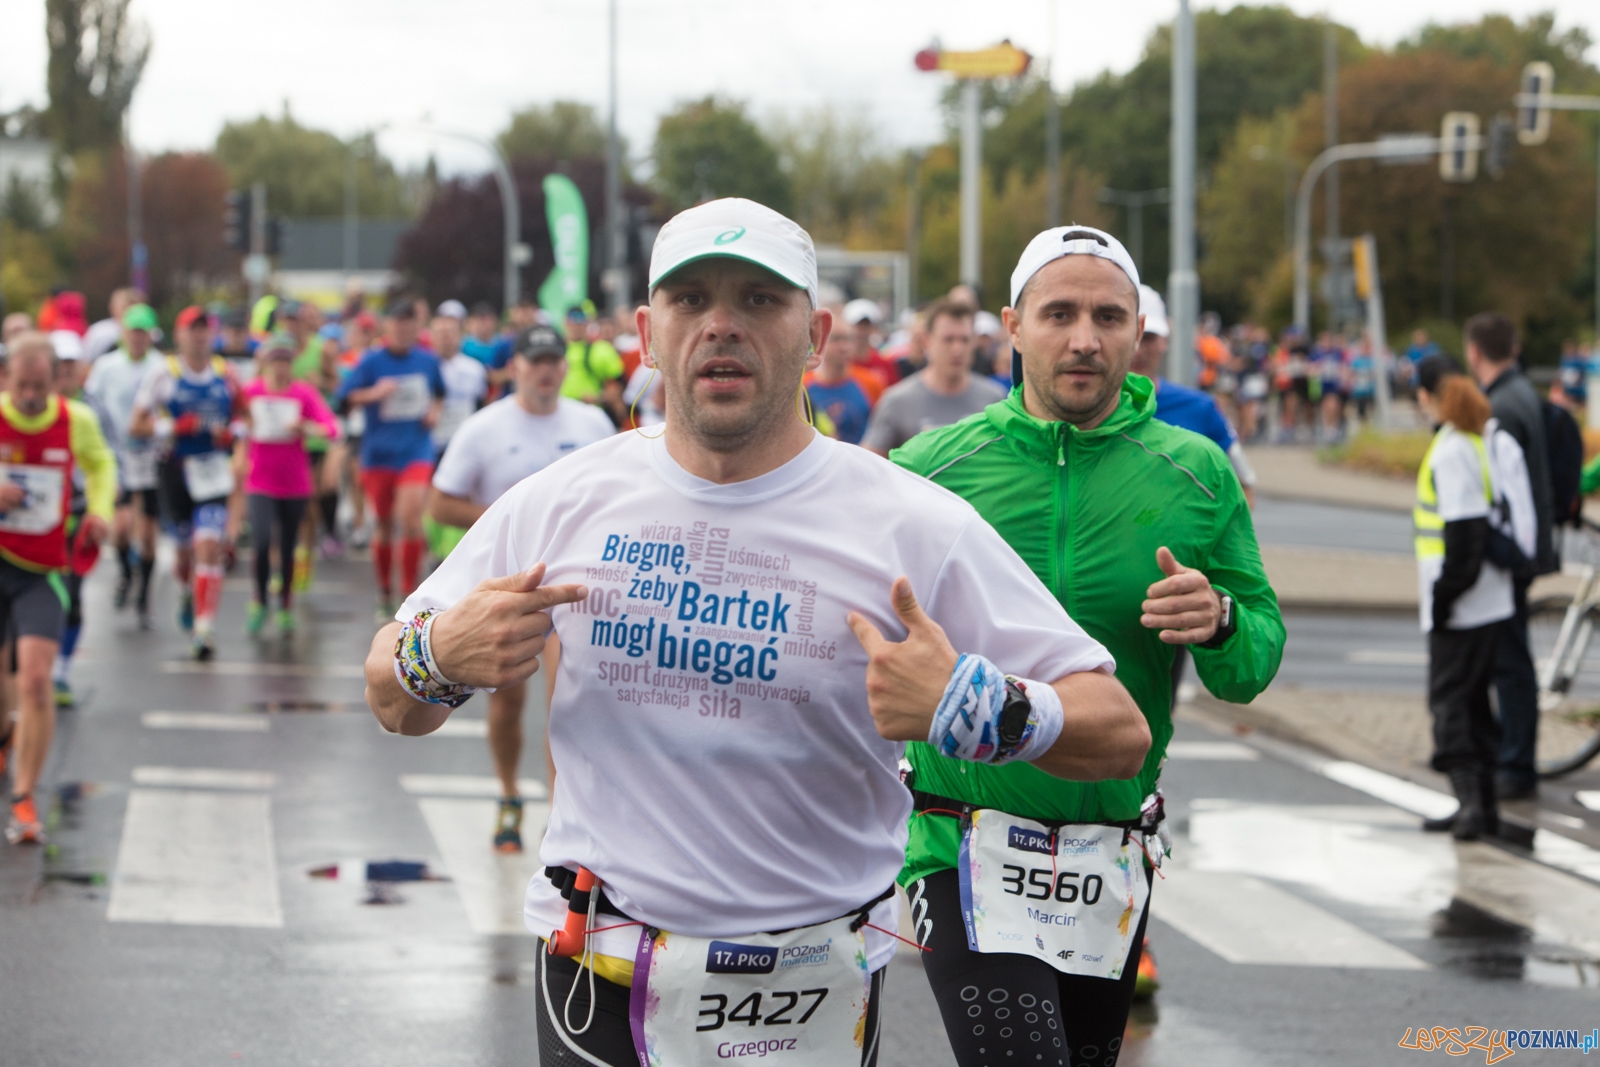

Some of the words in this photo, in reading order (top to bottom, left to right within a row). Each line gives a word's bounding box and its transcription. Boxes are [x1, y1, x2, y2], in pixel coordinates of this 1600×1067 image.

[640, 520, 682, 542] wiara
[686, 520, 708, 561] walka
[601, 534, 691, 575] Biegnę,
[696, 527, 730, 586] duma
[728, 547, 790, 571] uśmiech
[586, 564, 629, 583] radość
[725, 571, 798, 592] zwycięstwo
[625, 603, 673, 620] endorfiny
[627, 573, 679, 608] żeby
[678, 581, 791, 633] Bartek
[791, 580, 817, 639] jedność
[694, 625, 766, 643] zaangażowanie
[591, 614, 655, 657] mógł
[657, 623, 779, 685] biegać
[783, 637, 836, 660] miłość
[598, 660, 651, 687] sport
[652, 669, 709, 693] drużyna
[617, 687, 690, 710] satysfakcja
[698, 688, 741, 719] siła
[736, 681, 810, 705] motywacja
[1013, 833, 1027, 846] 17.
[1002, 863, 1103, 906] 3560
[1027, 907, 1076, 927] Marcin
[714, 950, 735, 966] 17.
[737, 952, 772, 967] PKO
[780, 953, 829, 968] maraton
[1056, 950, 1075, 960] 4F
[696, 987, 829, 1032] 3427
[717, 1038, 797, 1059] Grzegorz
